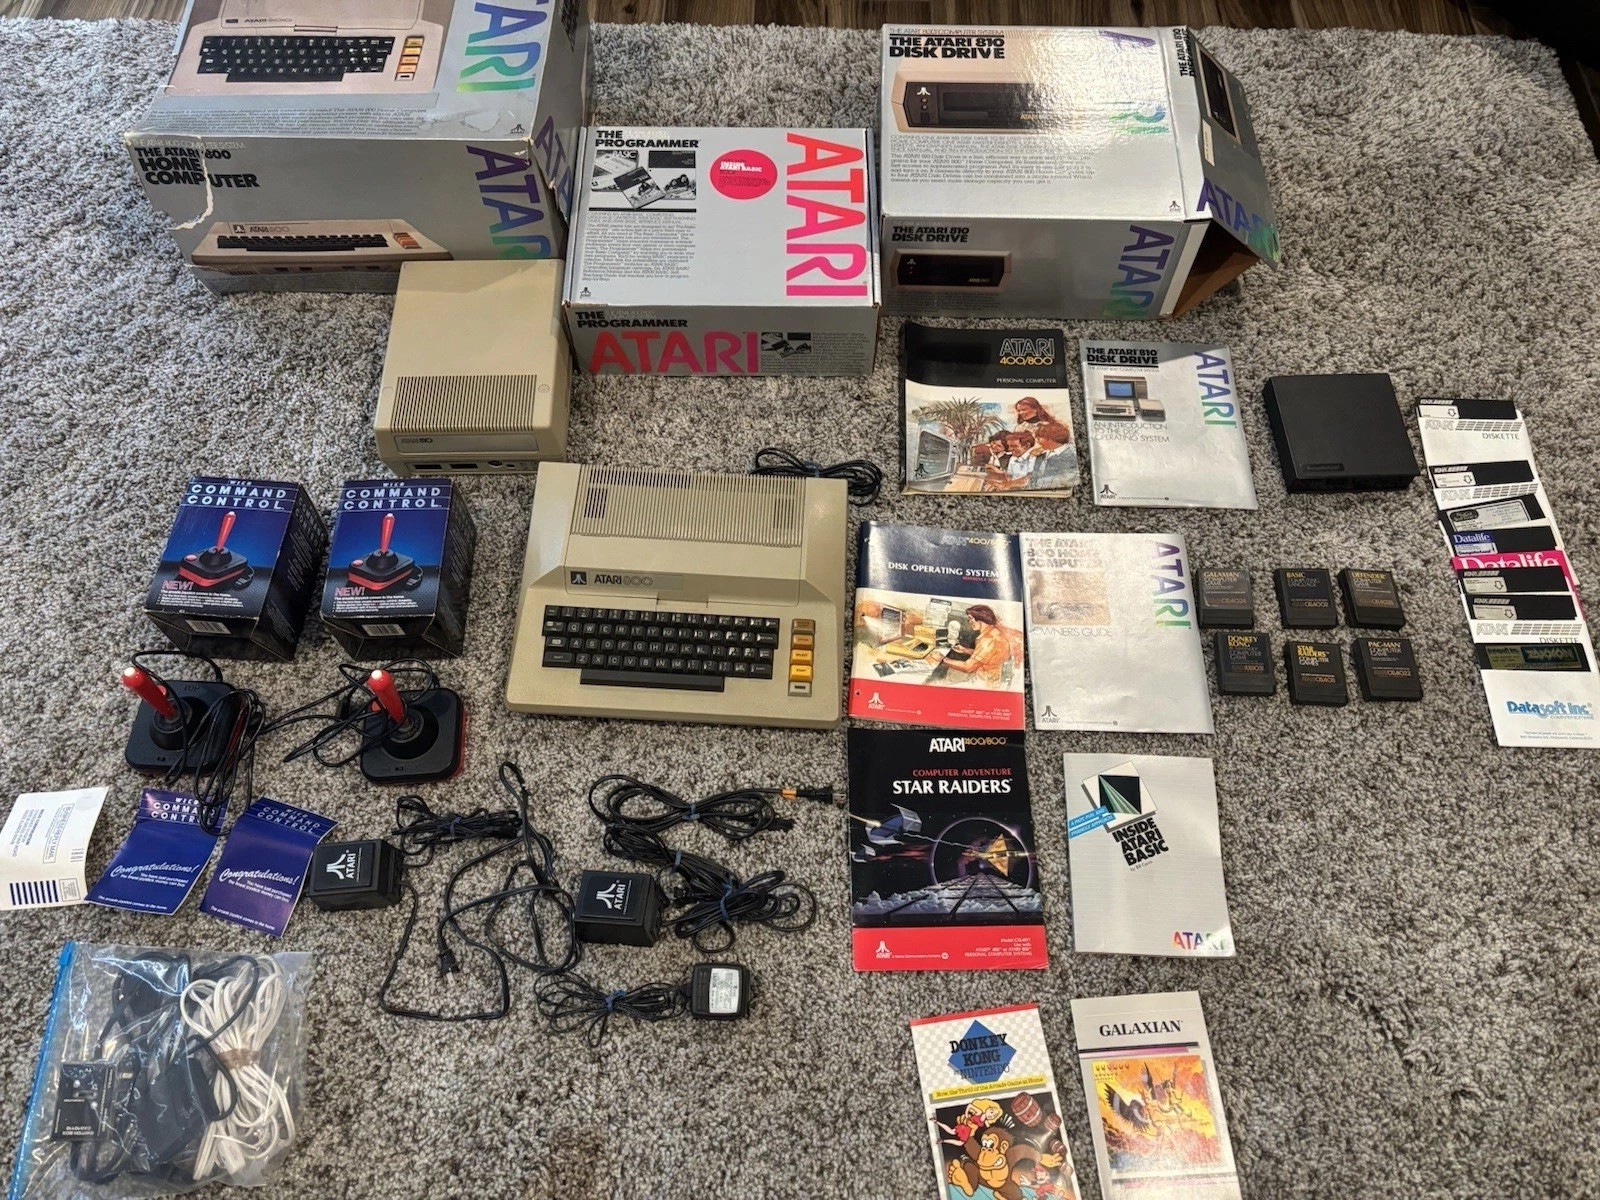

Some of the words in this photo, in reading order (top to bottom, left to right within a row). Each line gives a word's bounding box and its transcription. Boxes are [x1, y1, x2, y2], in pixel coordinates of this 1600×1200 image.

[456, 0, 549, 92] ARI
[890, 37, 922, 46] THE
[924, 37, 972, 47] ATARI
[975, 37, 1005, 47] 810
[889, 46, 938, 58] DISK
[941, 47, 1005, 59] DRIVE
[597, 130, 623, 138] THE
[595, 139, 699, 148] PROGRAMMER
[135, 147, 162, 157] THE
[164, 147, 201, 158] ATARI
[204, 149, 231, 160] 800
[138, 158, 202, 172] HOME
[145, 171, 259, 188] COMPUTER
[786, 132, 868, 296] ATARI
[891, 233, 925, 242] DISK
[925, 234, 969, 243] DRIVE
[950, 227, 970, 235] 810
[1102, 225, 1175, 317] ATARI
[575, 311, 605, 319] THE
[577, 319, 688, 328] PROGRAMMER
[589, 330, 759, 375] ATARI
[1000, 337, 1055, 358] ATARI
[1086, 347, 1105, 355] THE
[1108, 348, 1138, 356] ATARI
[1000, 356, 1054, 366] 400/800
[1087, 354, 1116, 363] DISK
[1119, 355, 1159, 364] DRIVE
[1194, 351, 1237, 426] ATARI
[1107, 422, 1168, 430] INTRODUCTION
[1123, 428, 1140, 436] DISK
[1094, 434, 1139, 442] OPERATING
[1482, 432, 1520, 440] DISKETTE
[191, 484, 286, 498] COMMAND
[345, 487, 441, 499] COMMAND
[187, 495, 283, 510] CONTROL
[344, 498, 438, 510] CONTROL
[1453, 532, 1491, 544] Datalife
[888, 561, 909, 571] DISK
[911, 563, 963, 576] OPERATING
[965, 568, 999, 578] SYSTEM
[1351, 571, 1386, 579] DEFENDER
[162, 580, 195, 590] NEW!
[594, 574, 622, 585] ATARI
[623, 576, 654, 586] 800
[1151, 541, 1191, 627] ATARI
[334, 586, 365, 596] NEW!
[1032, 626, 1080, 636] OWNER'S
[1081, 627, 1113, 637] GUIDE
[1506, 700, 1566, 719] Datasoft
[929, 737, 965, 753] ATARI
[965, 737, 1006, 746] 400/800
[912, 768, 959, 777] COMPUTER
[962, 767, 1012, 776] ADVENTURE
[893, 779, 934, 795] STAR
[938, 779, 1011, 794] RAIDERS
[153, 802, 215, 816] COMMA
[151, 811, 211, 825] CONTRL
[257, 812, 314, 834] CONTROL
[263, 806, 320, 828] COMMAND
[1112, 817, 1157, 842] INSIDE
[1121, 828, 1163, 854] ATARI
[1124, 840, 1169, 866] BASIC
[110, 861, 200, 878] Congratulations!
[345, 853, 357, 879] ATARI
[219, 867, 300, 885] Congratulations!
[613, 884, 626, 910] ATARI
[1099, 1019, 1182, 1037] GALAXIAN
[950, 1033, 1007, 1053] DONKEY
[963, 1050, 1000, 1067] KONG
[961, 1062, 1010, 1079] NINTENDO
[958, 1087, 974, 1095] Thrill
[989, 1082, 1007, 1091] Arcade
[1007, 1081, 1022, 1089] Game
[1028, 1077, 1044, 1085] Home
